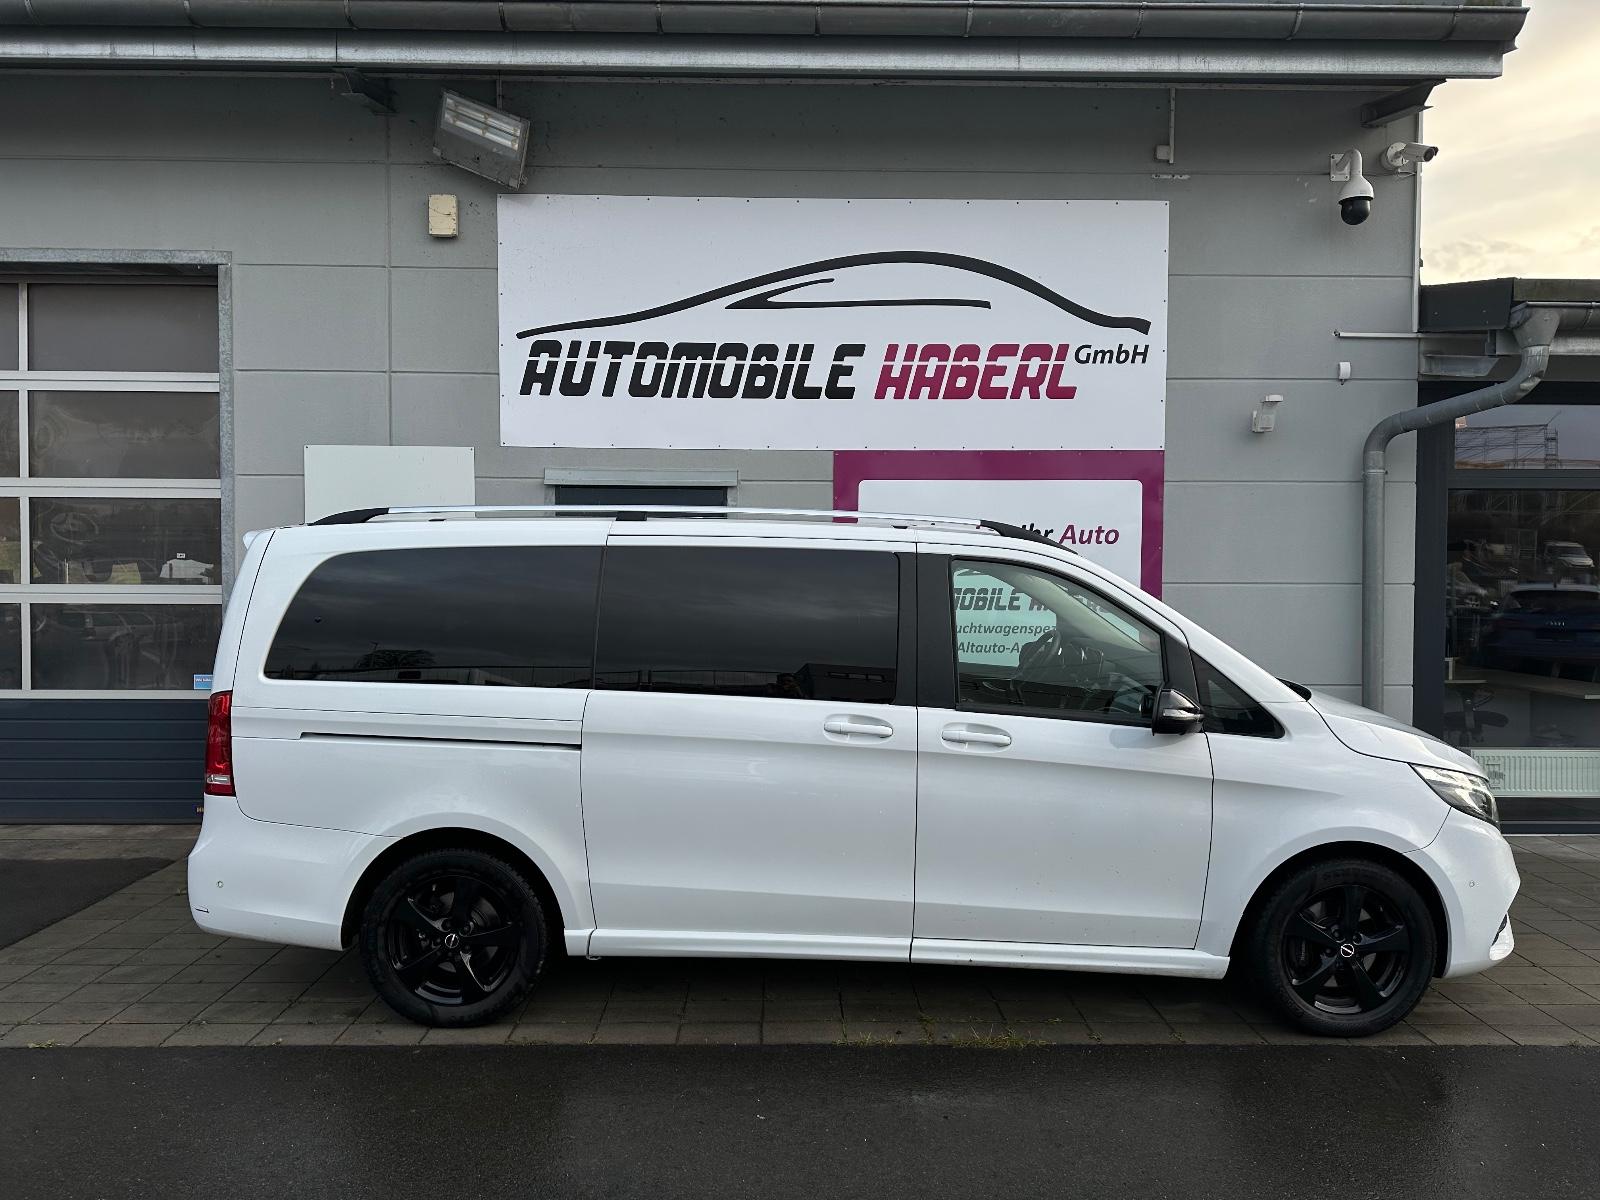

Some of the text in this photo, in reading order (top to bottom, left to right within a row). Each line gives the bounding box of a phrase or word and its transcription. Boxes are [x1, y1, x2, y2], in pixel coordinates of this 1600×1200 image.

[519, 339, 1149, 400] AUTOMOBILE HABERL GmbH
[1021, 522, 1120, 545] hr Auto
